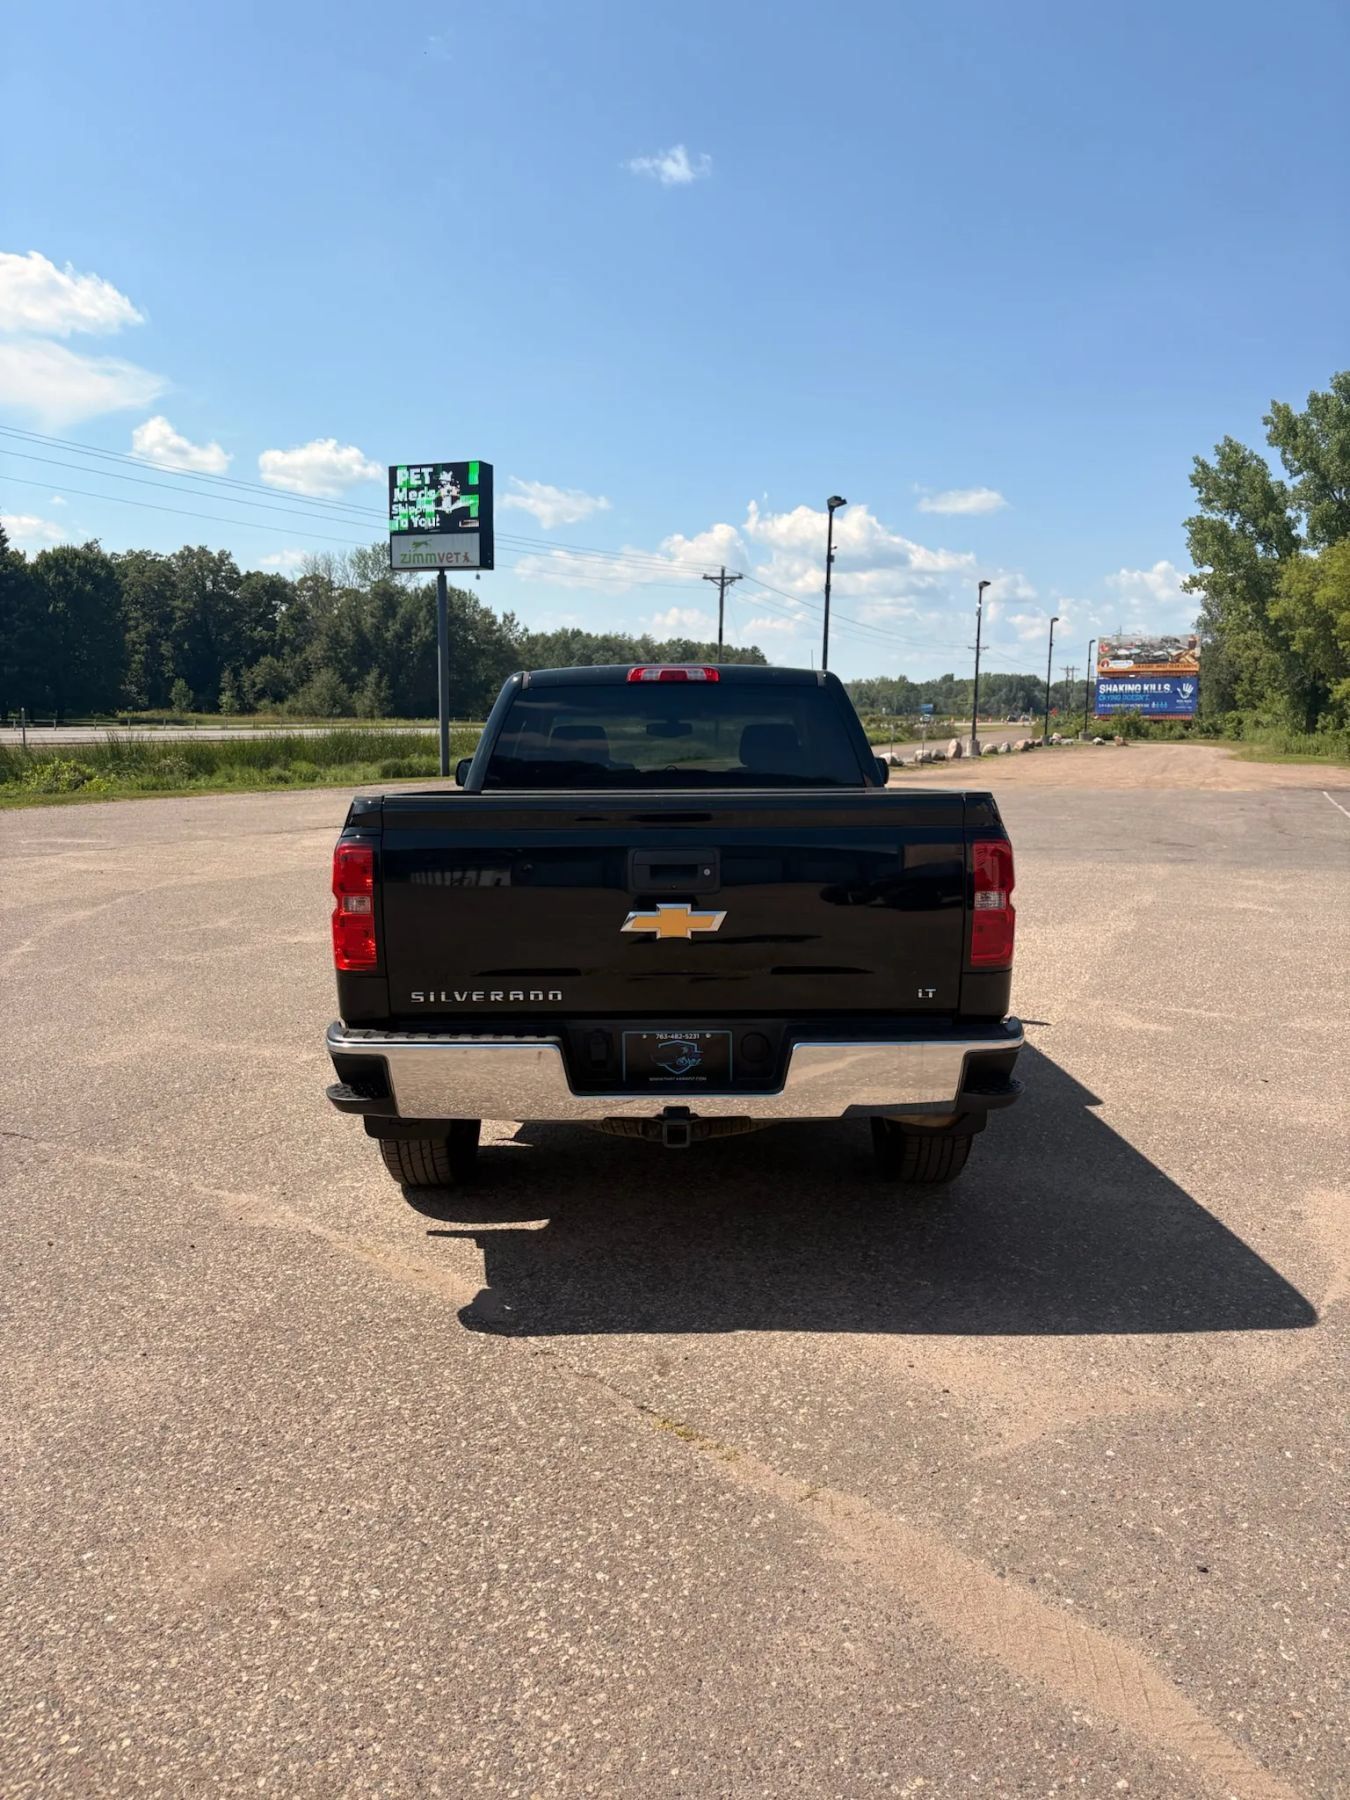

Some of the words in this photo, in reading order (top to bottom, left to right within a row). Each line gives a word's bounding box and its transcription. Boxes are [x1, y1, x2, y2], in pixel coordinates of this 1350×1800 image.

[396, 467, 434, 487] PET
[393, 486, 436, 502] Meds
[410, 514, 440, 528] You!
[1099, 683, 1142, 694] SHAKING
[1143, 683, 1173, 694] KILLS.
[411, 990, 562, 1002] SILVERADO
[918, 988, 937, 998] LT
